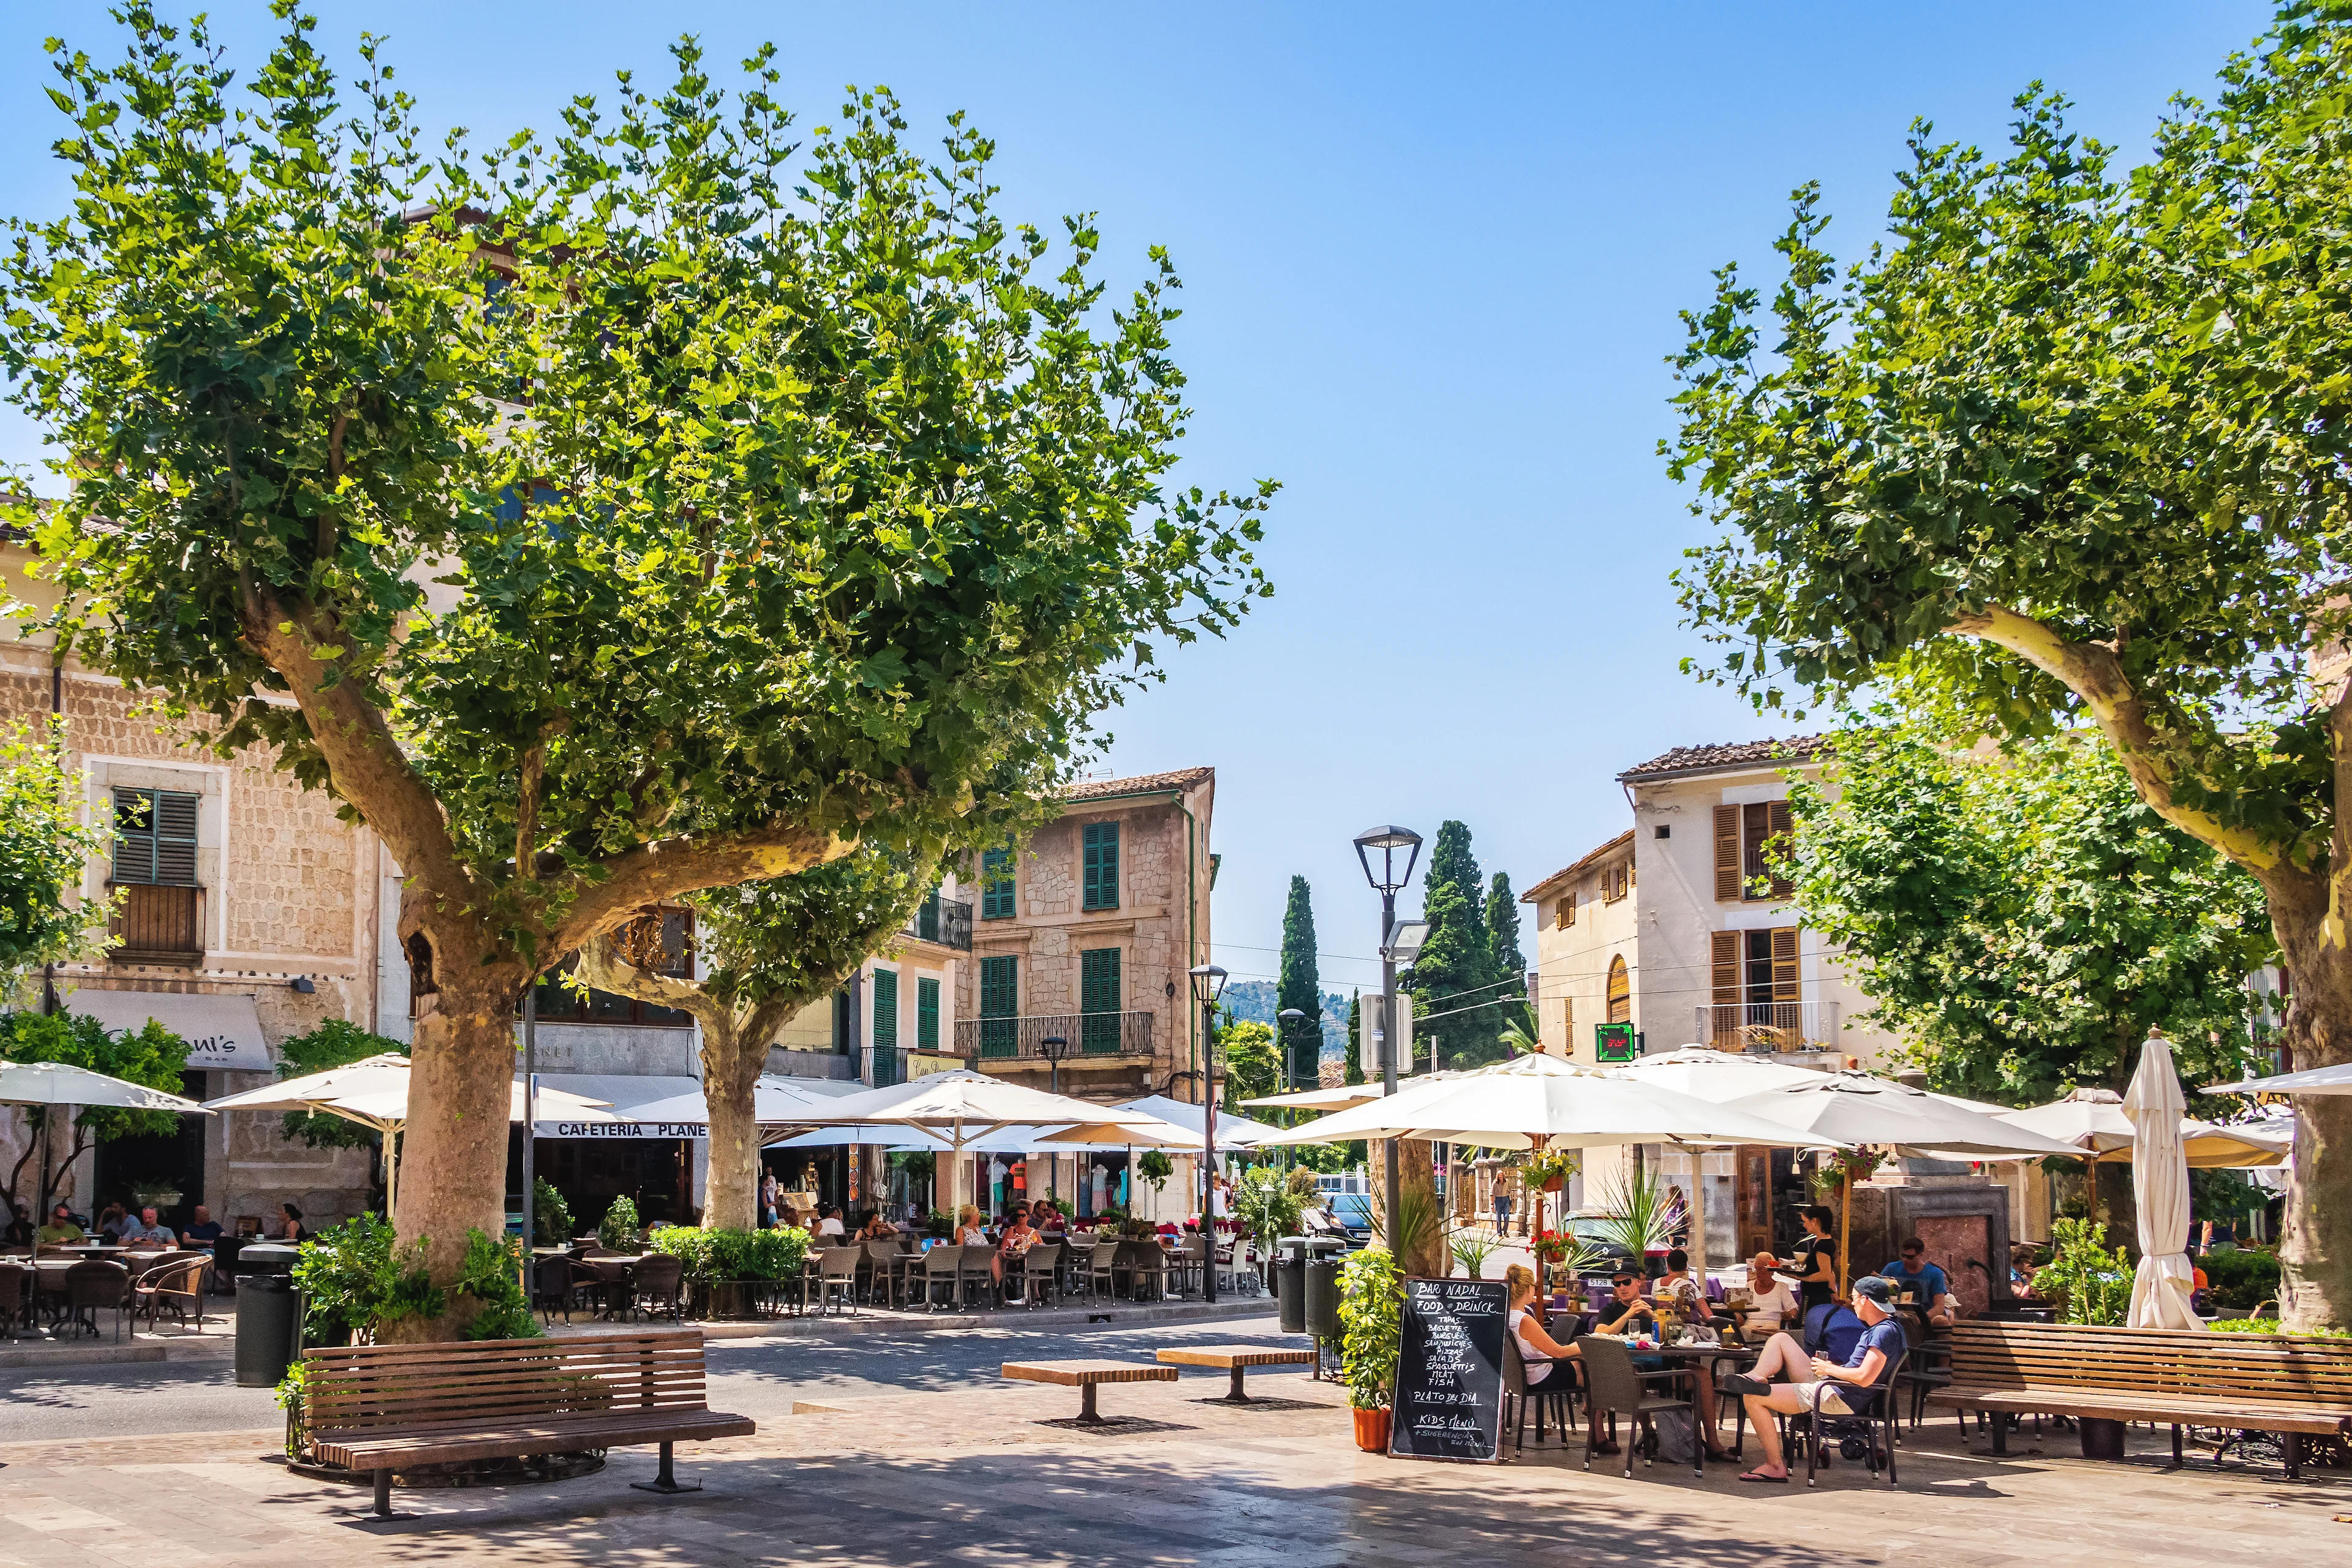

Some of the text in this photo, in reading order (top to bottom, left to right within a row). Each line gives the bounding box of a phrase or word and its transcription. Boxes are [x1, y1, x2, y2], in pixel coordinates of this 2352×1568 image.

[913, 1058, 929, 1077] Can
[558, 1123, 709, 1137] CAFETERIA PLANE
[1417, 1282, 1481, 1296] BAR NADAL
[1417, 1300, 1444, 1313] FOOD
[1431, 1332, 1471, 1341] BURGUERS
[1427, 1355, 1461, 1365] SALADS
[1432, 1370, 1455, 1379] MEAT
[1414, 1390, 1445, 1401] PLATO
[1446, 1393, 1458, 1403] DEL
